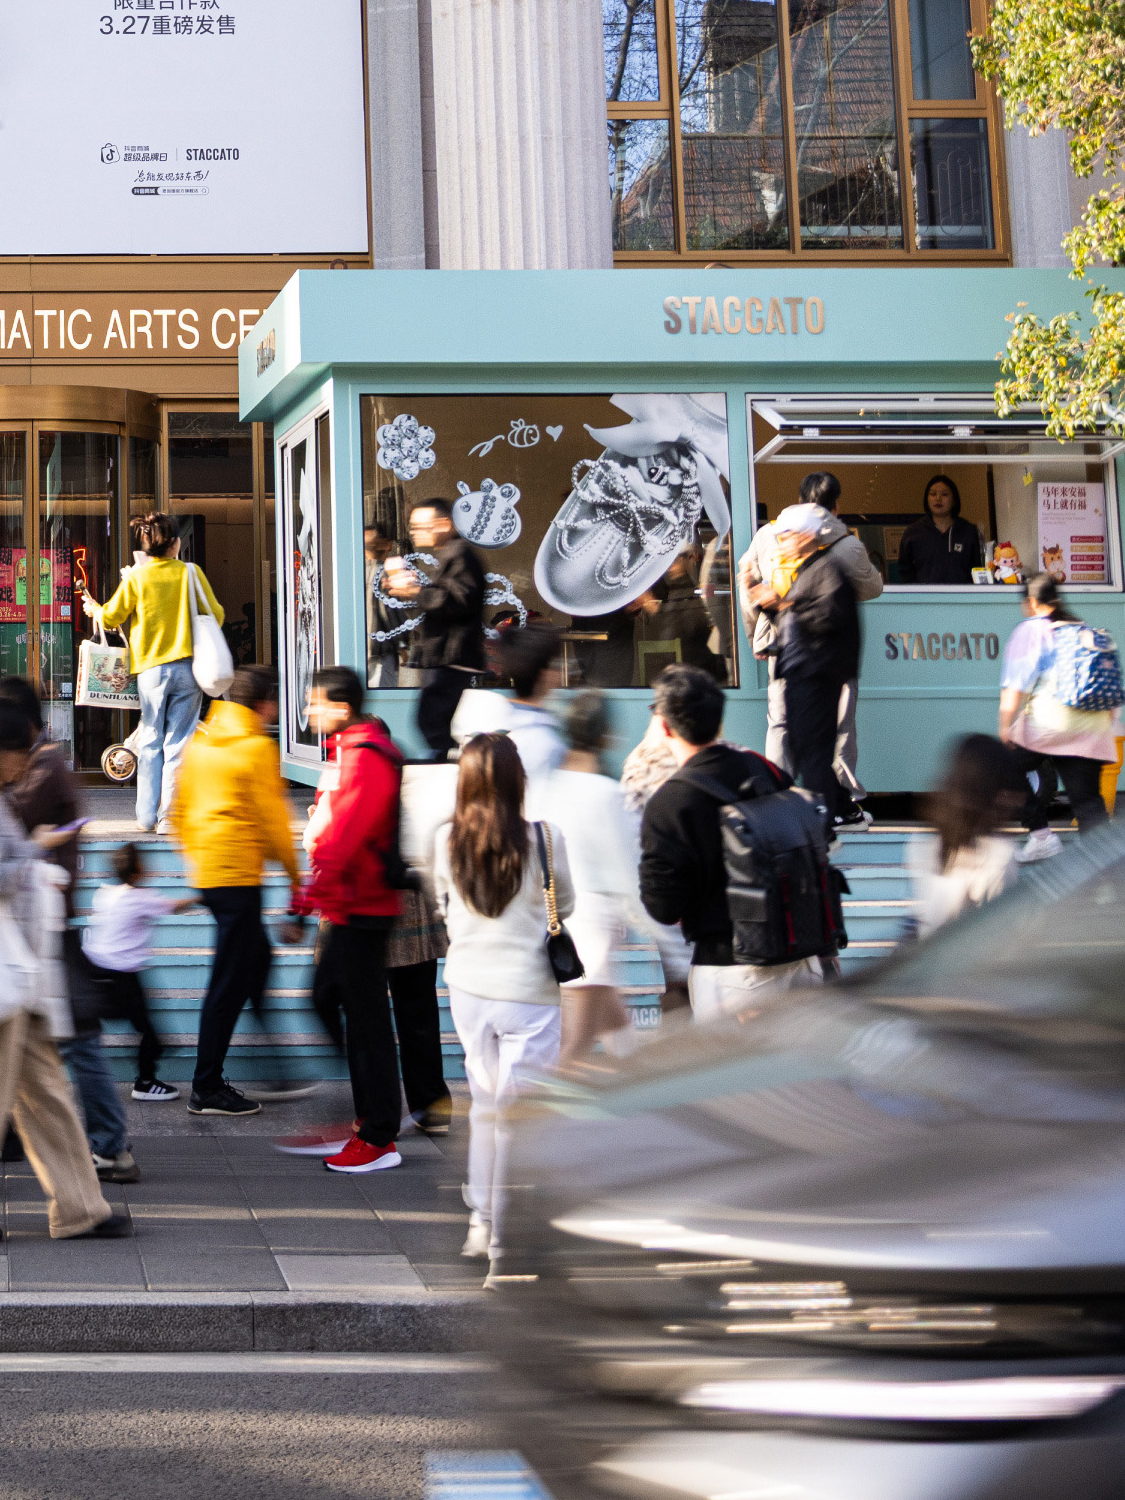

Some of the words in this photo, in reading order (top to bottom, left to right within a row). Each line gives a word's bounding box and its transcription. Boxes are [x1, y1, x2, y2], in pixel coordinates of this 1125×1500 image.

[99, 14, 236, 36] 3.27重磅发售
[123, 152, 168, 162] 超级品牌日
[186, 148, 240, 161] STACCATO
[664, 296, 825, 335] STACCATO
[104, 308, 200, 349] ARTS
[211, 307, 266, 350] CE
[1042, 486, 1087, 498] 马年来安福
[1042, 499, 1087, 510] 马上就有福
[884, 631, 1000, 661] STACCATO
[89, 692, 140, 701] DUNHUANG
